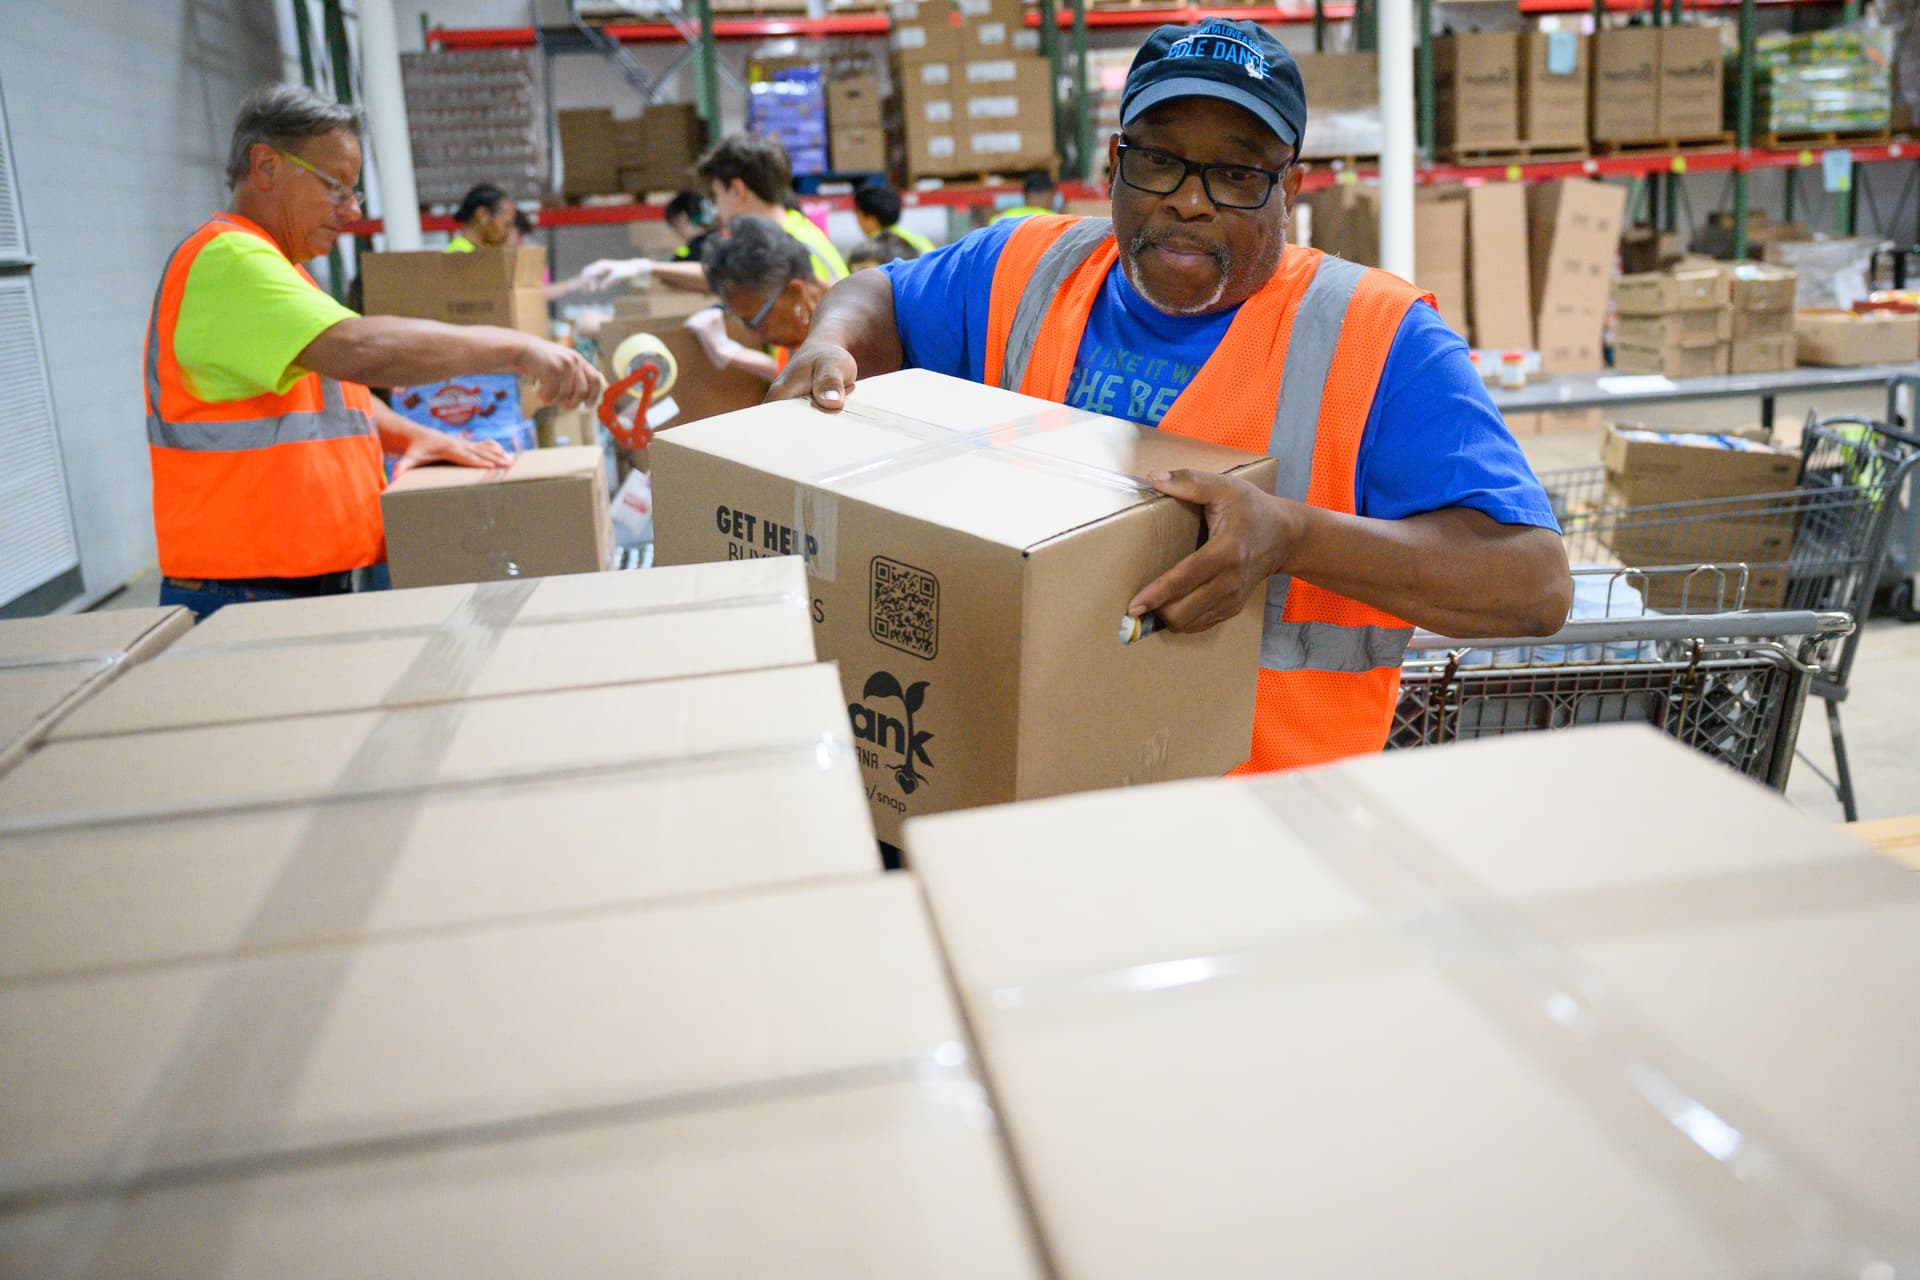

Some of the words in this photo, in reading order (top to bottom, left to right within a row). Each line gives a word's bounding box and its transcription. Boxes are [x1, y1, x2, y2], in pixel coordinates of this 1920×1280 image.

[1222, 26, 1242, 41] LOVE
[1101, 347, 1144, 373] LIKE
[1144, 359, 1169, 380] IT
[716, 505, 756, 542] GET
[763, 519, 819, 562] HELP
[847, 702, 935, 768] ank
